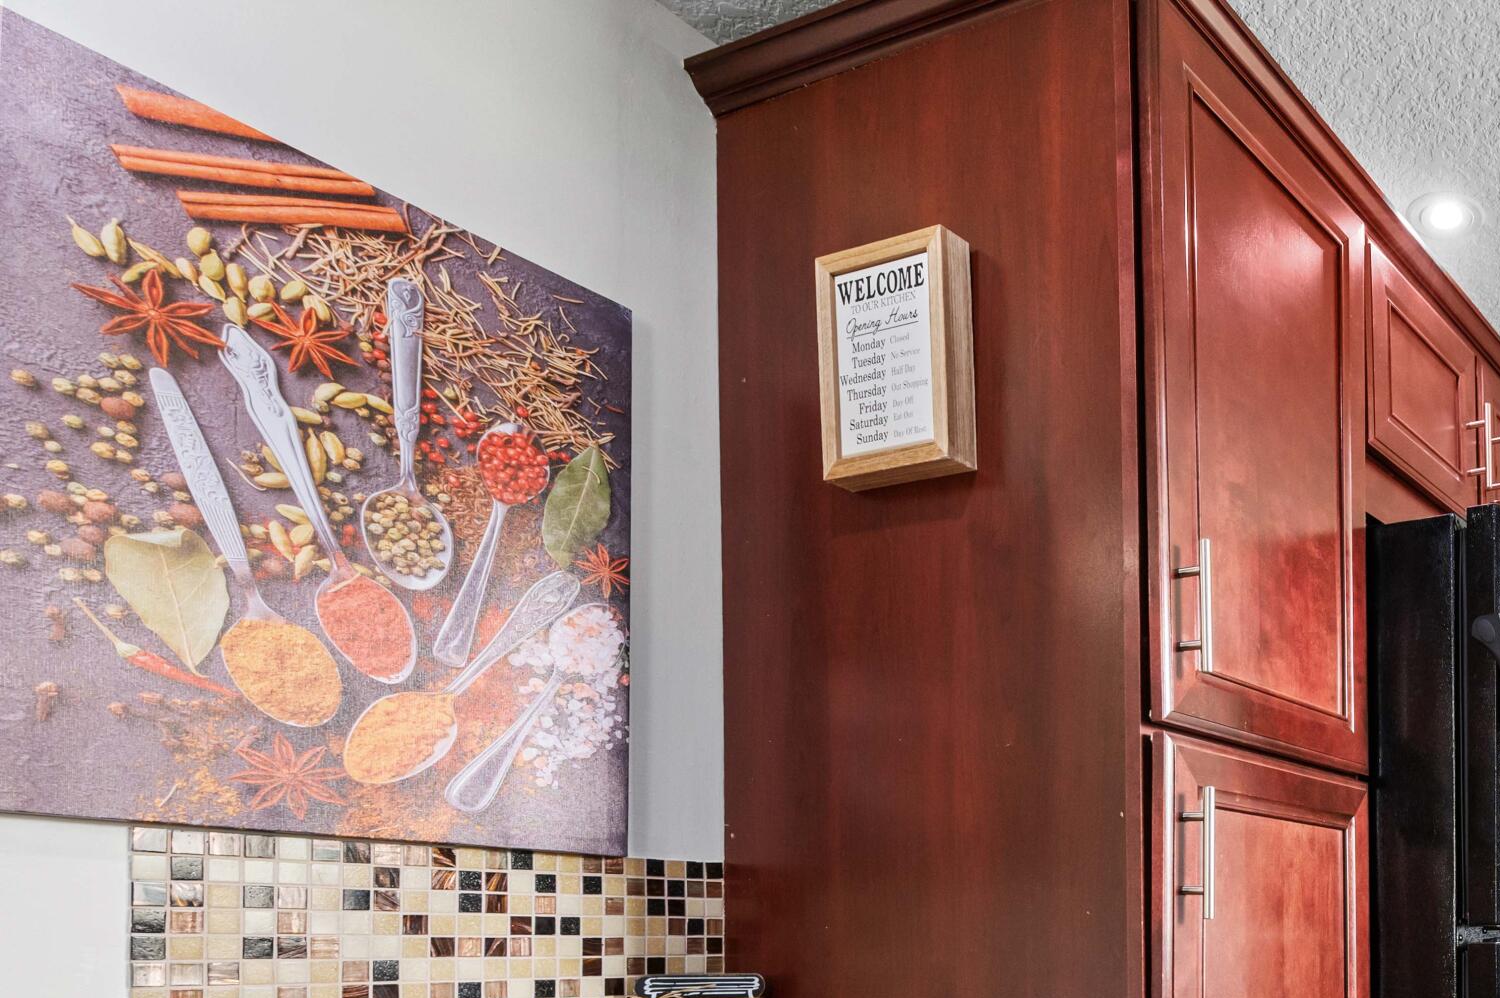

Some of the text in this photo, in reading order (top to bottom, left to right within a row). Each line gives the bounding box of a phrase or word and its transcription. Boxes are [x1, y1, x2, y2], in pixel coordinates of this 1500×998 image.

[837, 262, 925, 306] WELCOME
[851, 290, 916, 315] TO OUR KITCHEN
[846, 305, 918, 342] Opening Hours
[852, 338, 886, 354] Monday
[851, 352, 886, 369] Tuesday
[840, 368, 887, 387] Wednesday
[847, 384, 887, 402] Thursday
[859, 400, 888, 415] Friday
[849, 414, 889, 431] Saturday
[856, 430, 889, 445] Sunday
